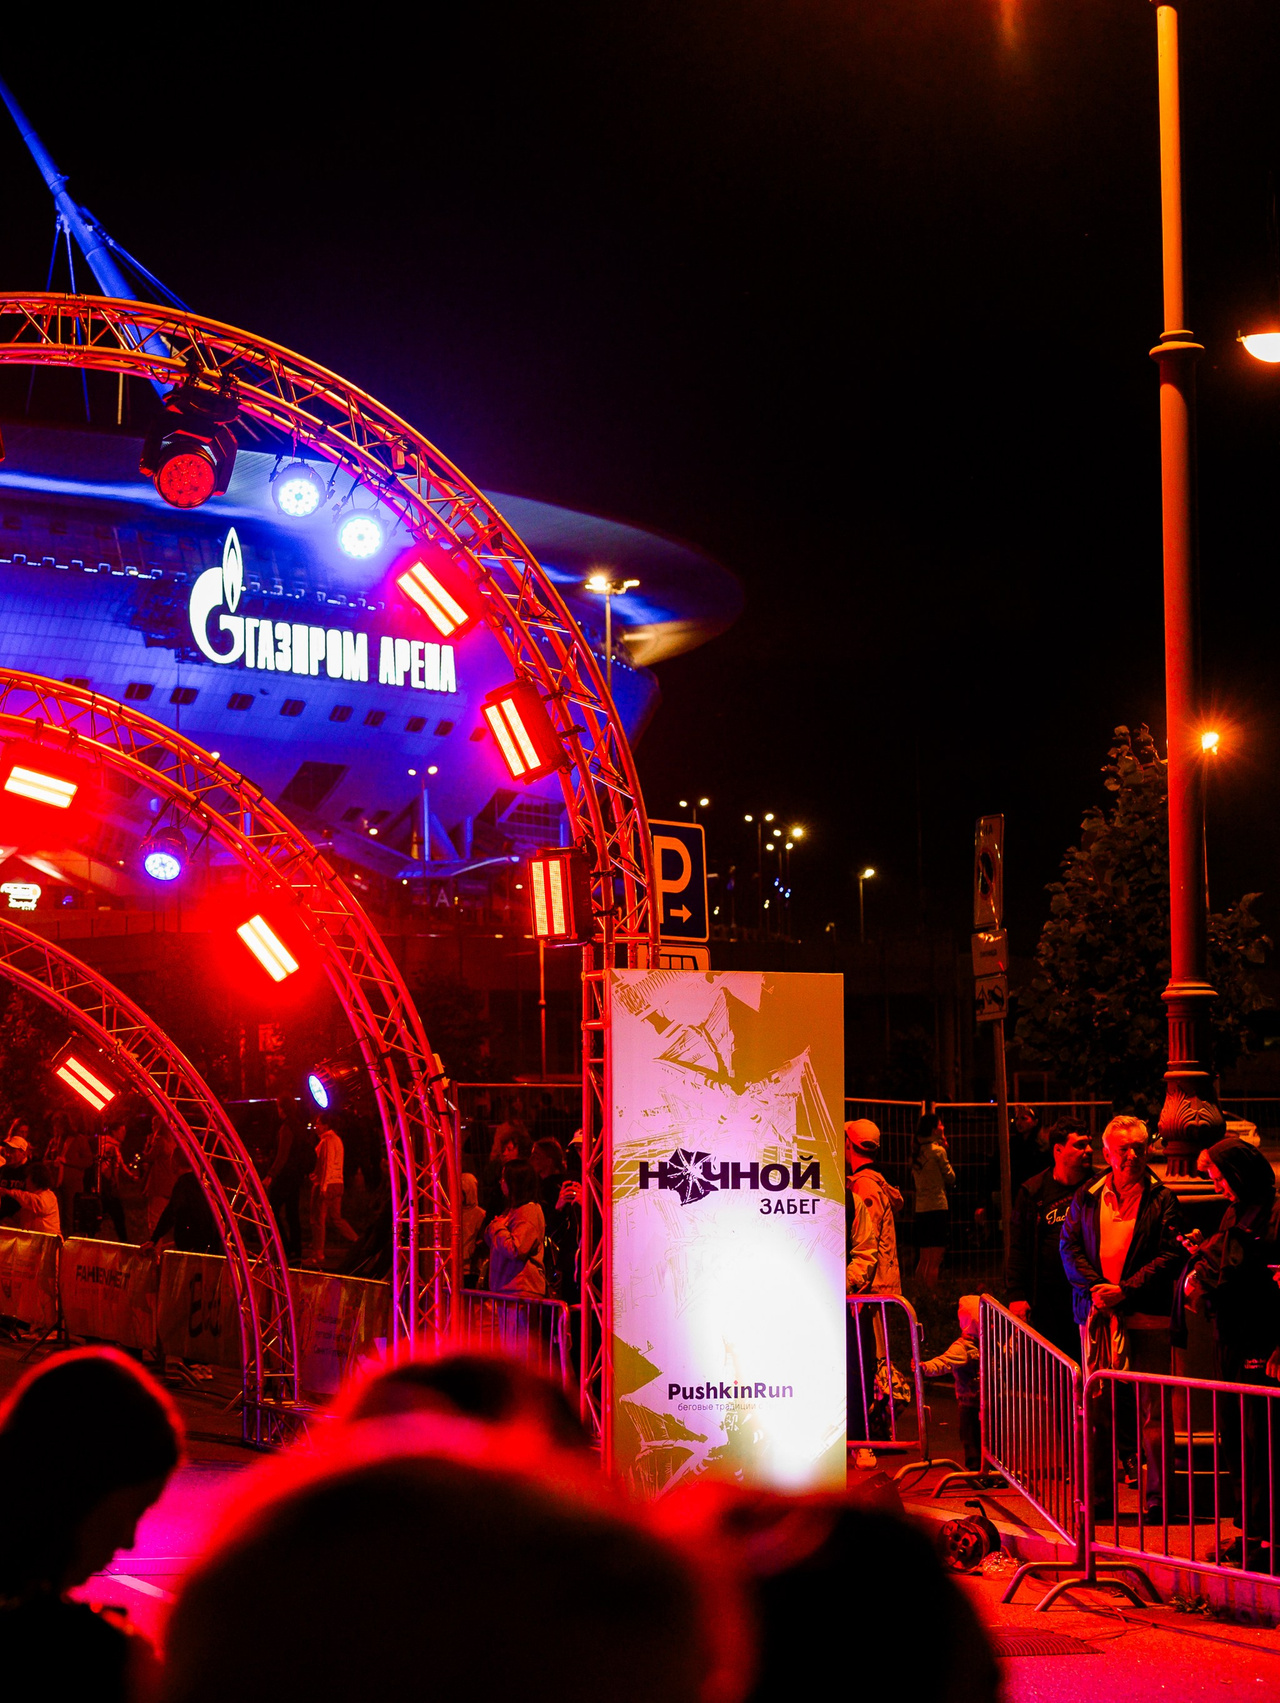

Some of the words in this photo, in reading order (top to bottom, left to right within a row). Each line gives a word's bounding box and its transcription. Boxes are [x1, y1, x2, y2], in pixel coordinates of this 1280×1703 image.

[245, 617, 368, 682] ГАЗПРОМ
[379, 636, 457, 692] АРЕНА
[653, 835, 692, 924] P
[759, 1198, 821, 1215] ЗАБЕГ
[668, 1379, 794, 1400] PushkinRun
[677, 1402, 714, 1411] беговые
[715, 1403, 757, 1411] традиции
